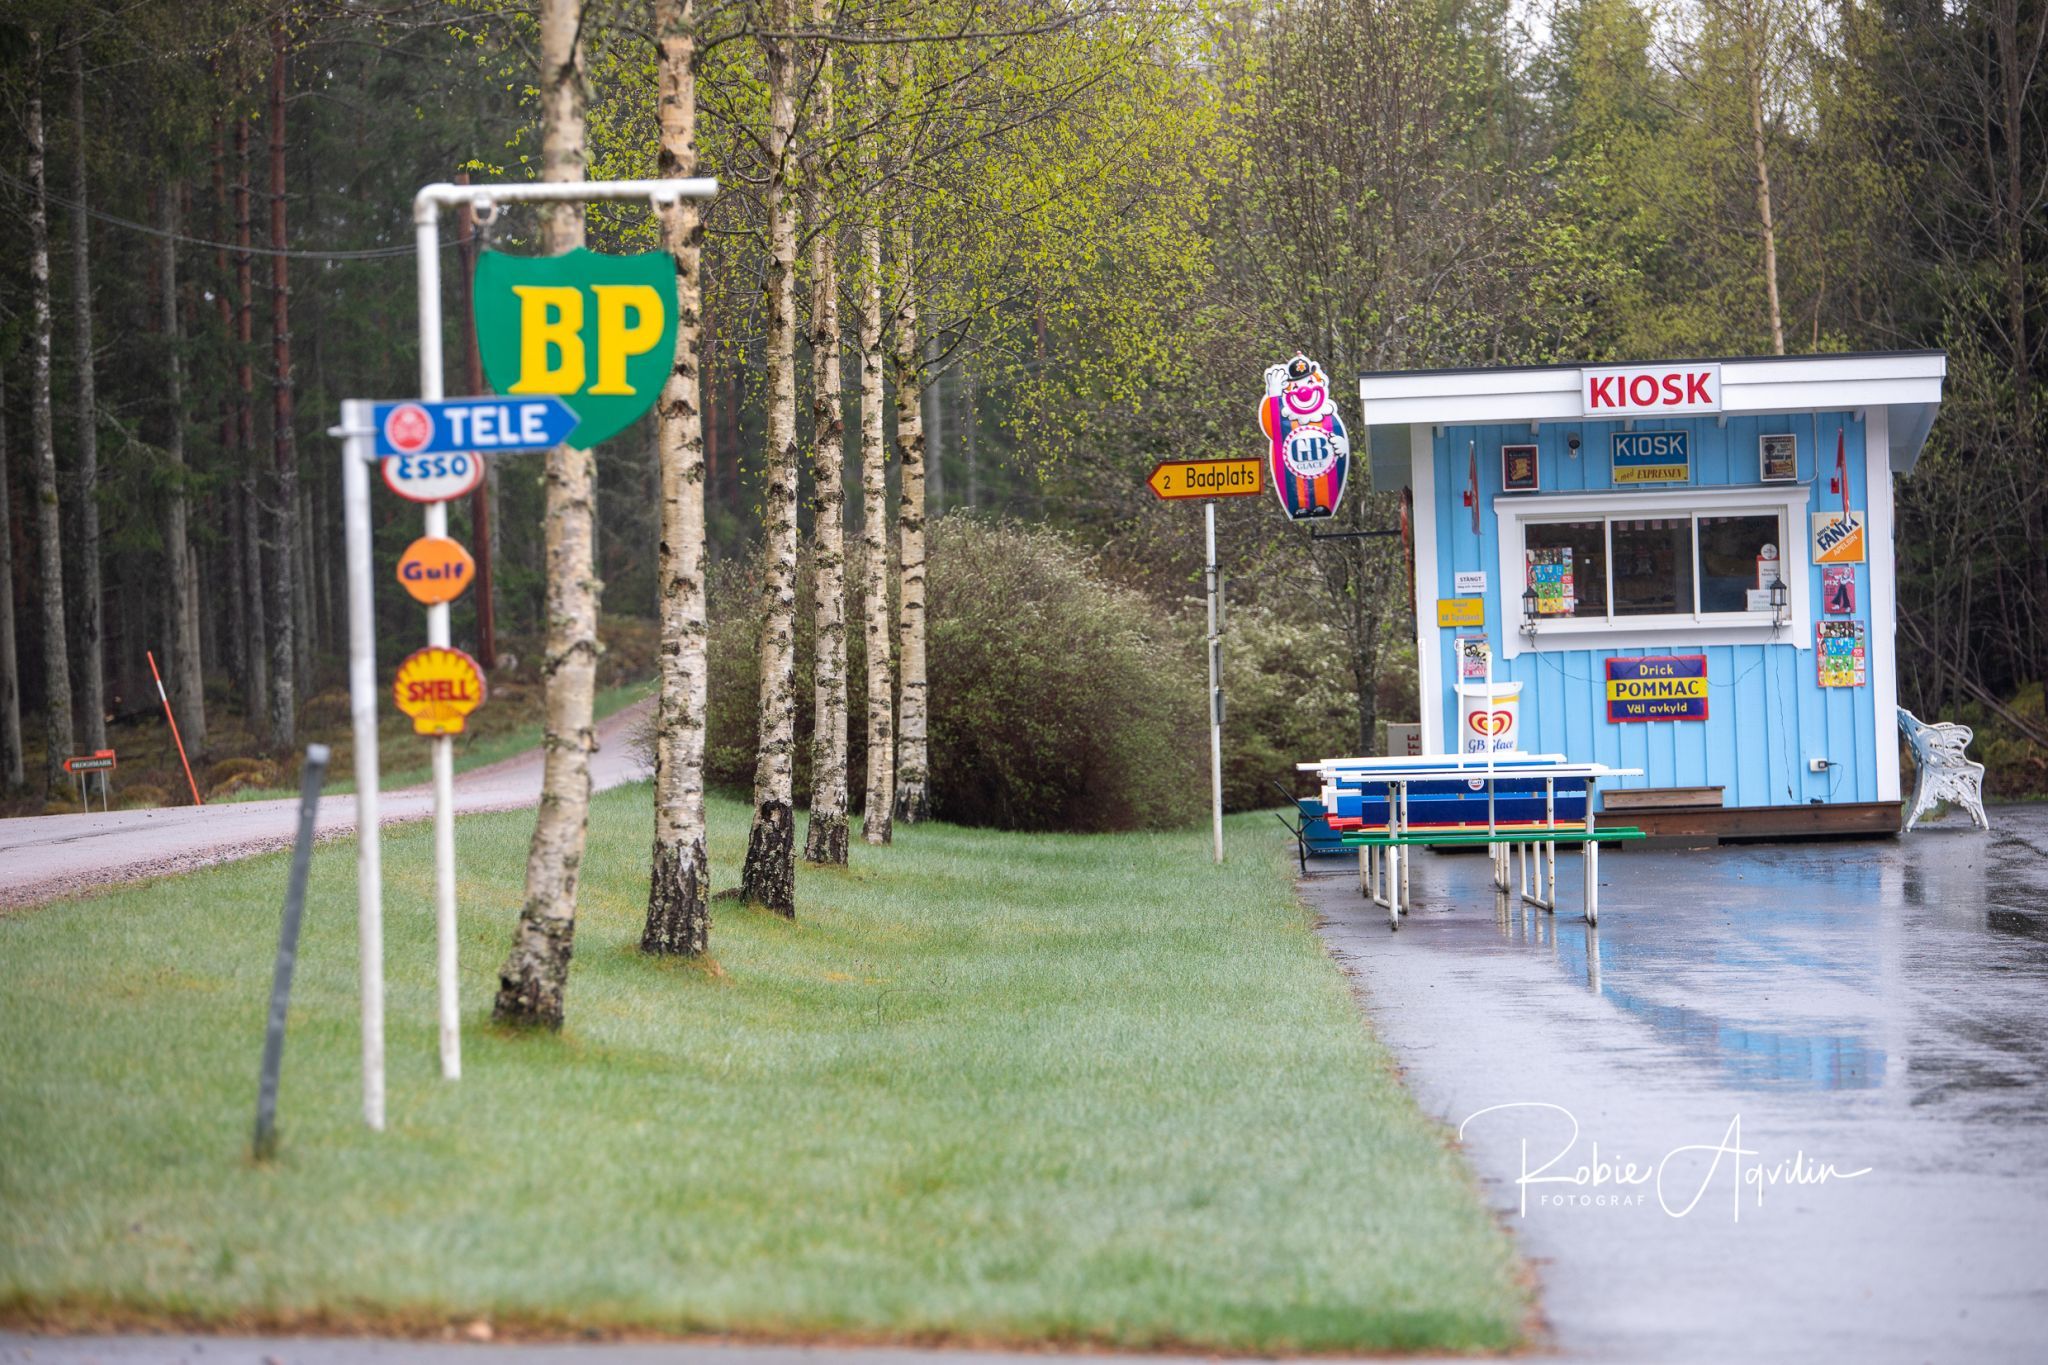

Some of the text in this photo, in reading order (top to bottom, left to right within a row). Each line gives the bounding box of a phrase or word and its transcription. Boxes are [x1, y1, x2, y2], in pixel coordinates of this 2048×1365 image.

[507, 284, 665, 395] BP
[1590, 372, 1713, 408] KIOSK
[443, 403, 549, 447] TELE
[1291, 437, 1329, 463] GB
[1616, 435, 1684, 457] KIOSK
[1163, 464, 1254, 491] 2 Badplats
[1637, 468, 1682, 480] EXPRESSEN
[403, 561, 464, 580] Gulf
[1640, 663, 1674, 676] Drick
[408, 679, 471, 702] SHELL
[1616, 680, 1699, 697] POMMAC
[1626, 702, 1688, 714] Väl avkyld
[1468, 739, 1486, 753] GB
